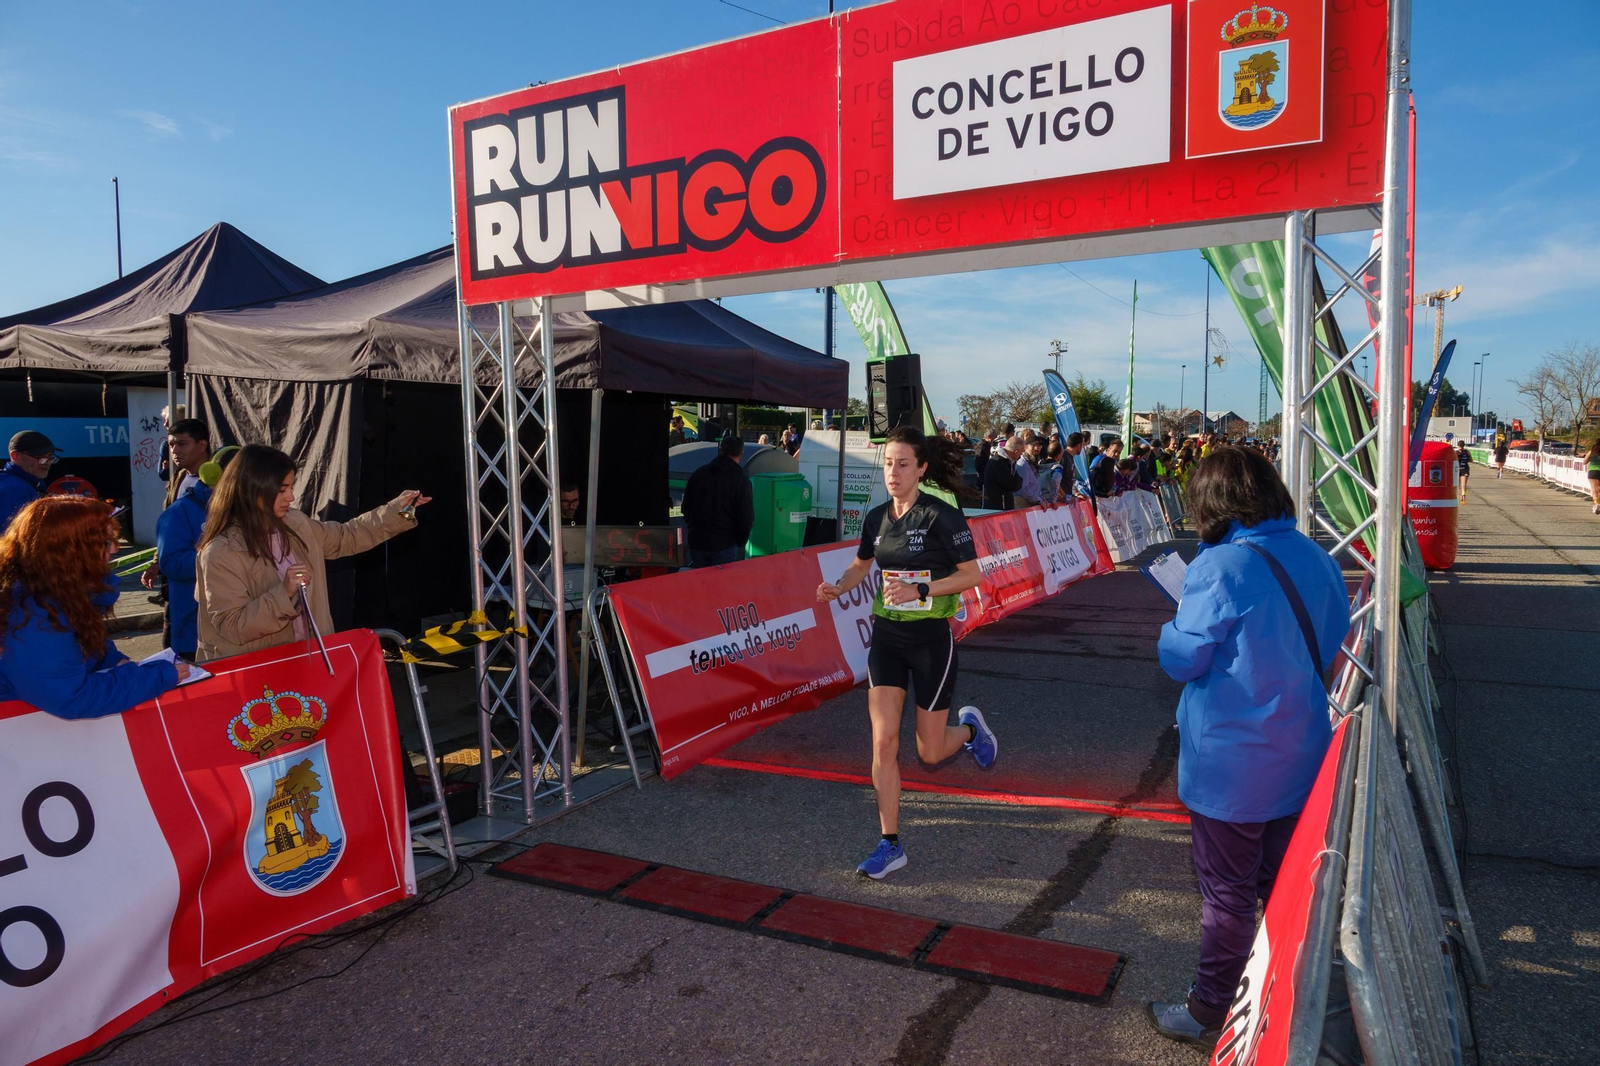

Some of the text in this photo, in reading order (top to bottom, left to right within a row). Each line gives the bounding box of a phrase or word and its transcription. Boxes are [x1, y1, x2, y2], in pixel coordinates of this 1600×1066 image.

[853, 10, 965, 58] Subida
[978, 0, 1021, 31] Ao
[911, 46, 1145, 120] CONCELLO
[471, 98, 620, 196] RUN
[938, 101, 1115, 161] DE VIGO
[853, 210, 967, 243] Cáncer
[1001, 195, 1078, 229] Vigo
[1191, 171, 1238, 203] La
[1256, 158, 1300, 196] 21
[85, 425, 130, 444] TRA
[1036, 522, 1074, 549] CONCELLO
[1047, 547, 1080, 574] DE VIGO
[717, 602, 767, 636] VIGO,
[690, 622, 802, 675] terreo de xogo
[751, 702, 758, 713] A
[760, 690, 792, 711] MELLOR
[792, 679, 818, 697] CIDADE
[818, 674, 834, 687] PARA
[833, 669, 847, 682] VIVIR
